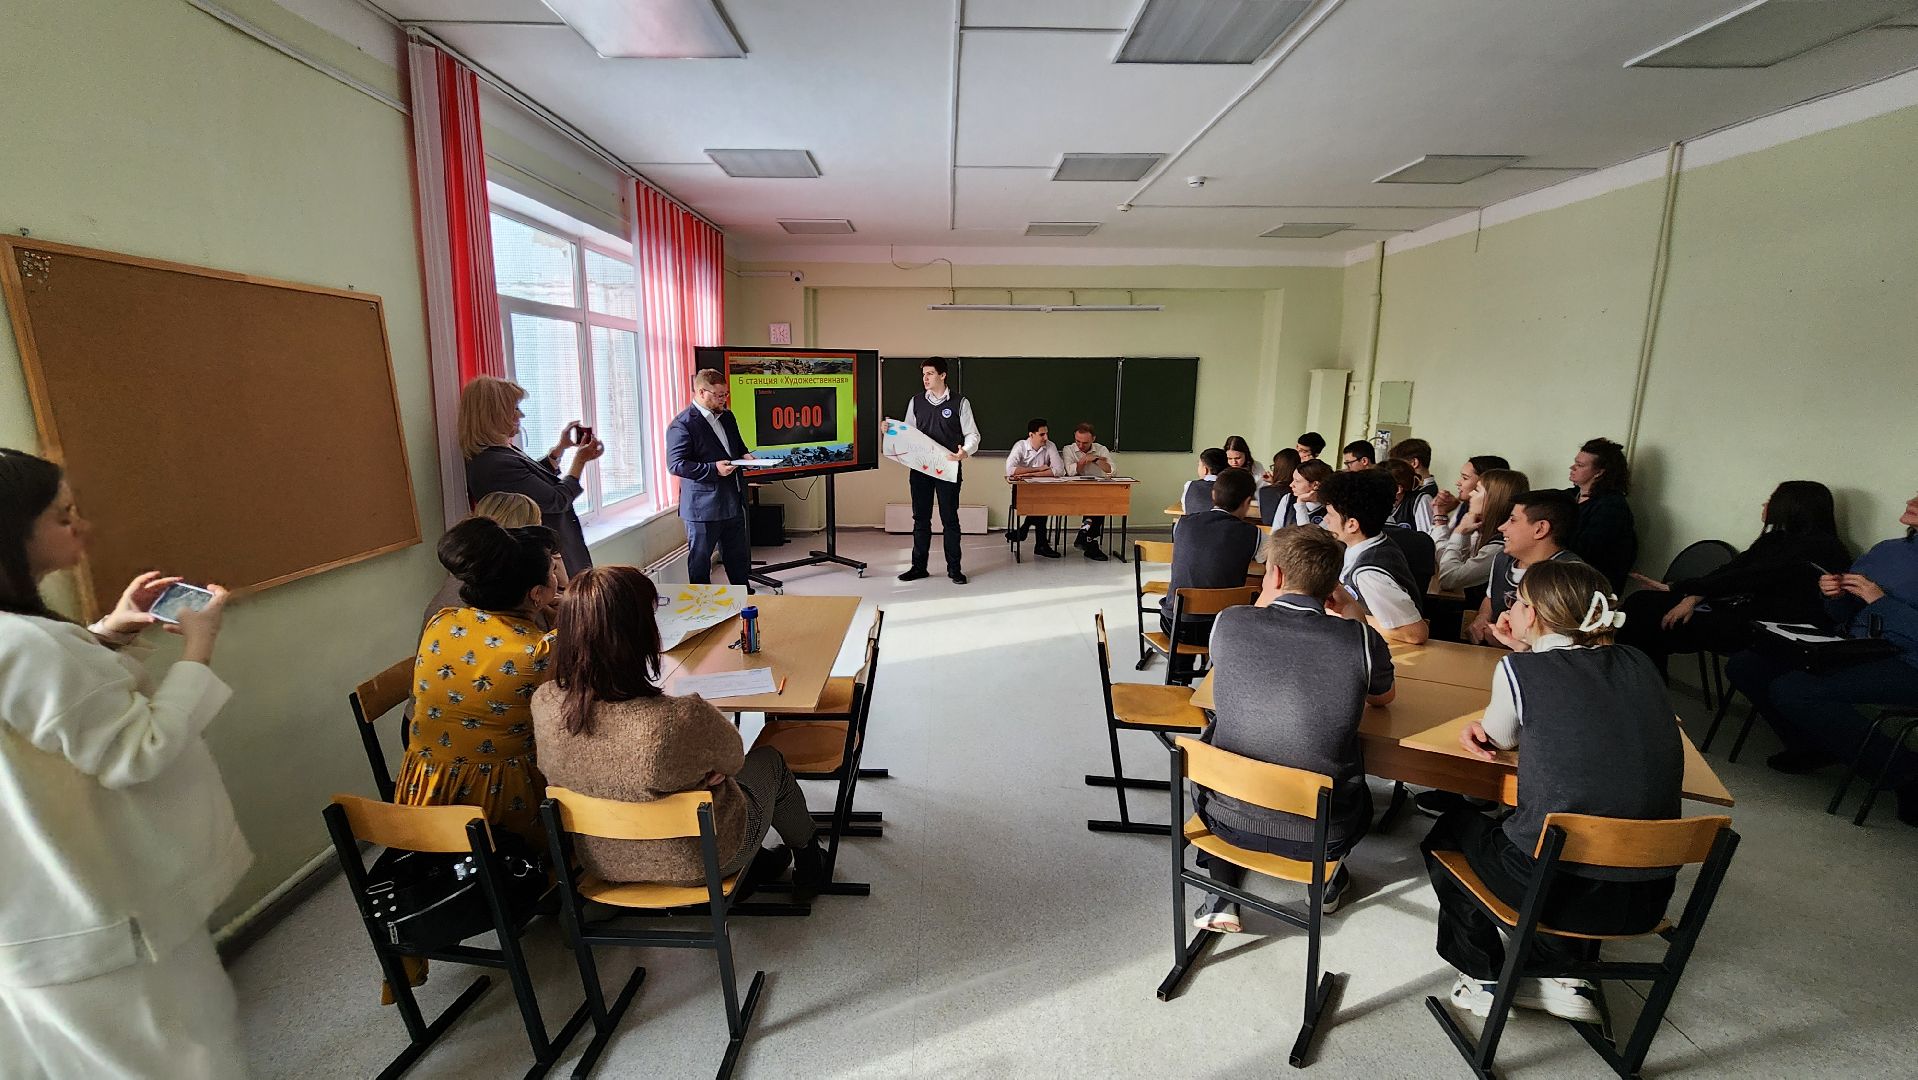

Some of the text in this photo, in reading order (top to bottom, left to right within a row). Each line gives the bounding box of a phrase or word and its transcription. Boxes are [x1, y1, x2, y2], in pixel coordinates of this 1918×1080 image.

[745, 377, 778, 386] станция
[780, 376, 849, 385] «Художественная»
[772, 405, 822, 430] 00:00
